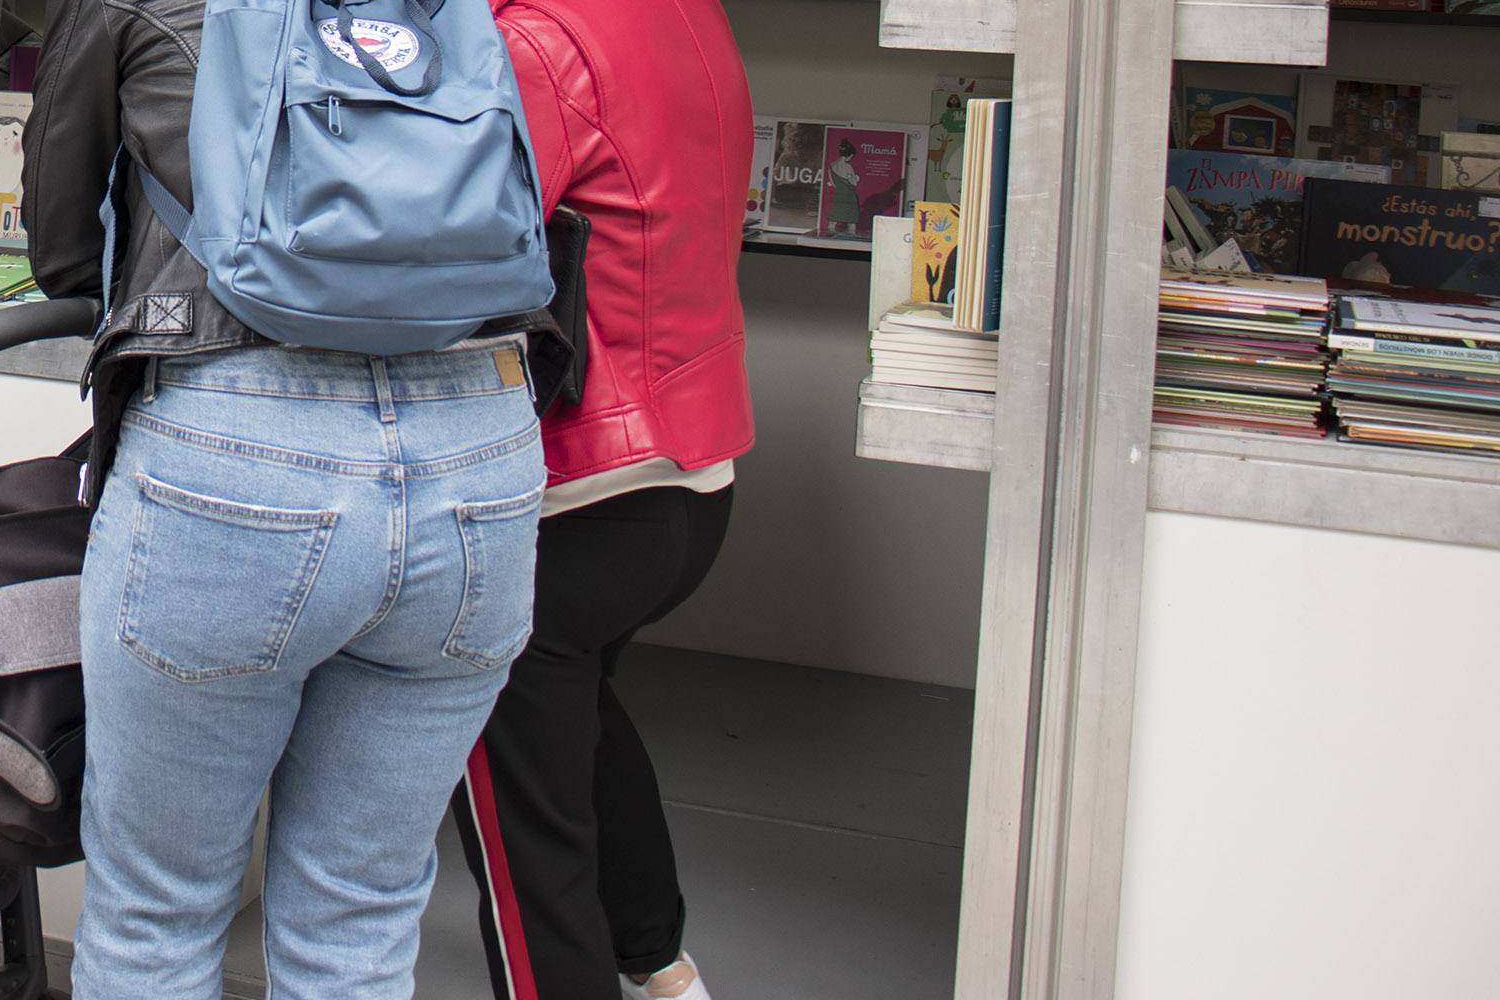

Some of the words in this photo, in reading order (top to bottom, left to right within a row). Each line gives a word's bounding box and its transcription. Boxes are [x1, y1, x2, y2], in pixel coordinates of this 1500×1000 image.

[861, 143, 897, 155] Mamá
[1187, 166, 1263, 192] ZAMPA
[1381, 195, 1437, 216] ¿Estás
[1444, 202, 1477, 221] ahí,
[1337, 218, 1500, 253] monstruo?
[1379, 343, 1426, 354] MONSTRUOS
[1443, 349, 1465, 358] VIVEN
[1467, 352, 1493, 361] DONDE
